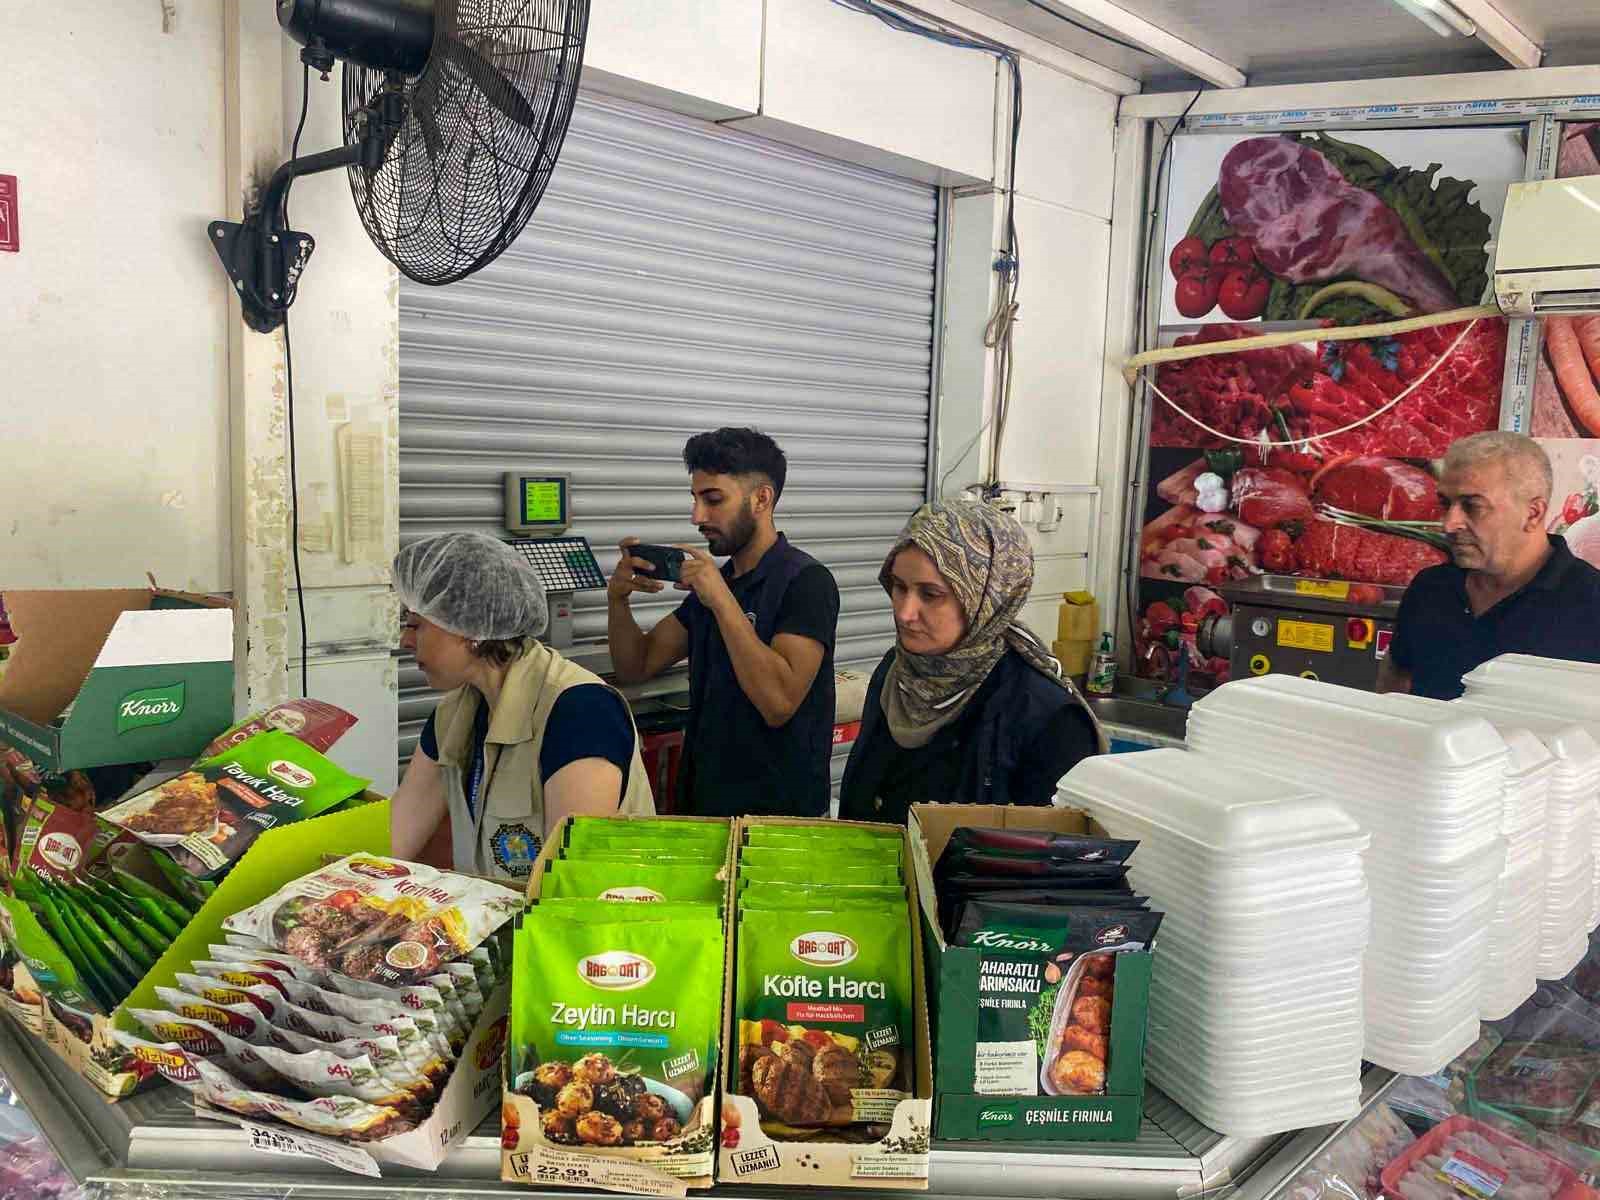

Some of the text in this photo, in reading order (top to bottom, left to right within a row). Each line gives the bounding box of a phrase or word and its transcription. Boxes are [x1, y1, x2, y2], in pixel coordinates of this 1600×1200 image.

[121, 699, 180, 717] Knorr
[222, 761, 267, 788] Tavuk
[973, 931, 1054, 952] Knorr
[979, 960, 1039, 977] AHARATLI
[764, 974, 886, 1000] Köfte Harcı
[979, 975, 1041, 993] ARIMSAKLI
[979, 997, 1000, 1009] ŞNİLE
[181, 1005, 224, 1021] Bizim
[551, 1002, 676, 1030] Zeytin Harcı
[154, 1023, 201, 1041] Bizim
[134, 1047, 177, 1067] Bizim
[157, 1062, 200, 1081] Mutfa
[980, 1108, 1113, 1124] Knorr ÇEŞNİLE FIRINLA
[740, 1149, 768, 1163] LEZZET
[739, 1160, 776, 1175] UZMANI!
